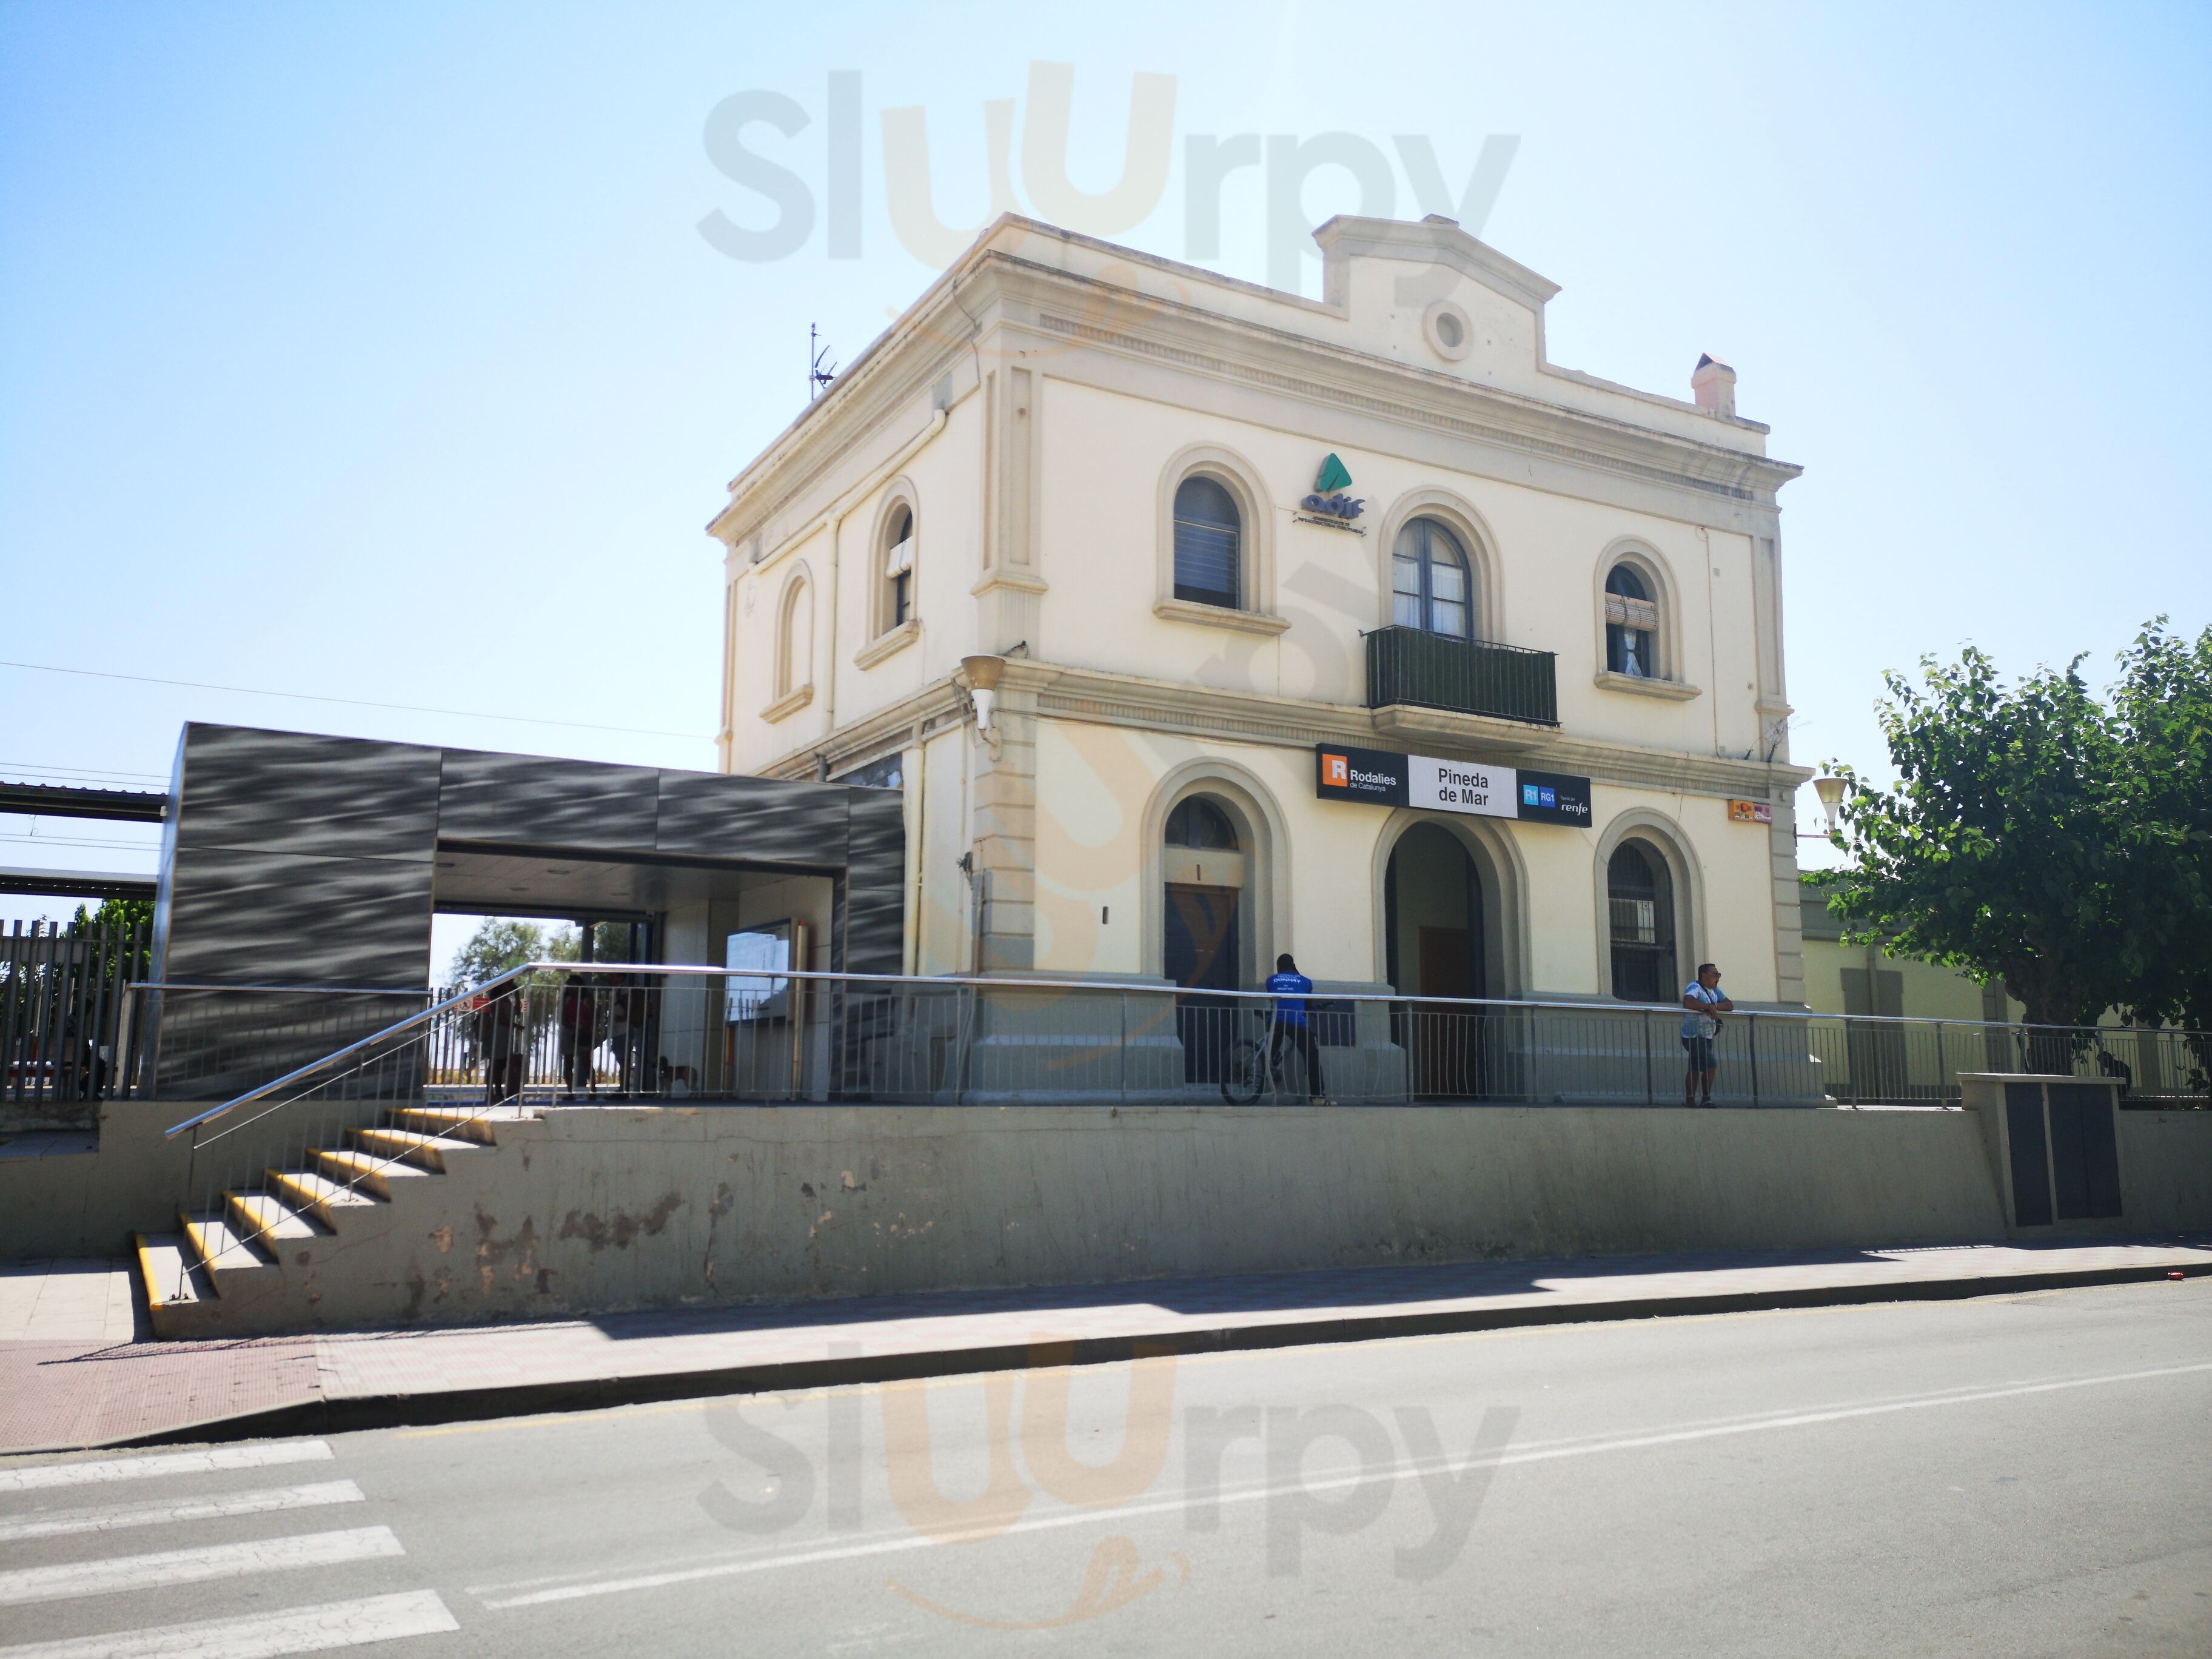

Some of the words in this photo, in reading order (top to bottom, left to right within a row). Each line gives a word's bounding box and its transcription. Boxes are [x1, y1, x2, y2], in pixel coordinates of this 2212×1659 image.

[1302, 493, 1365, 520] adif
[1332, 760, 1347, 779] R
[1350, 769, 1396, 786] Rodalies
[1438, 768, 1489, 788] Pineda
[1358, 782, 1386, 793] Catalunya
[1439, 786, 1457, 802] de
[1461, 789, 1489, 806] Mar
[1525, 789, 1537, 800] R1
[1541, 792, 1555, 802] RG1
[1561, 802, 1588, 816] renfe
